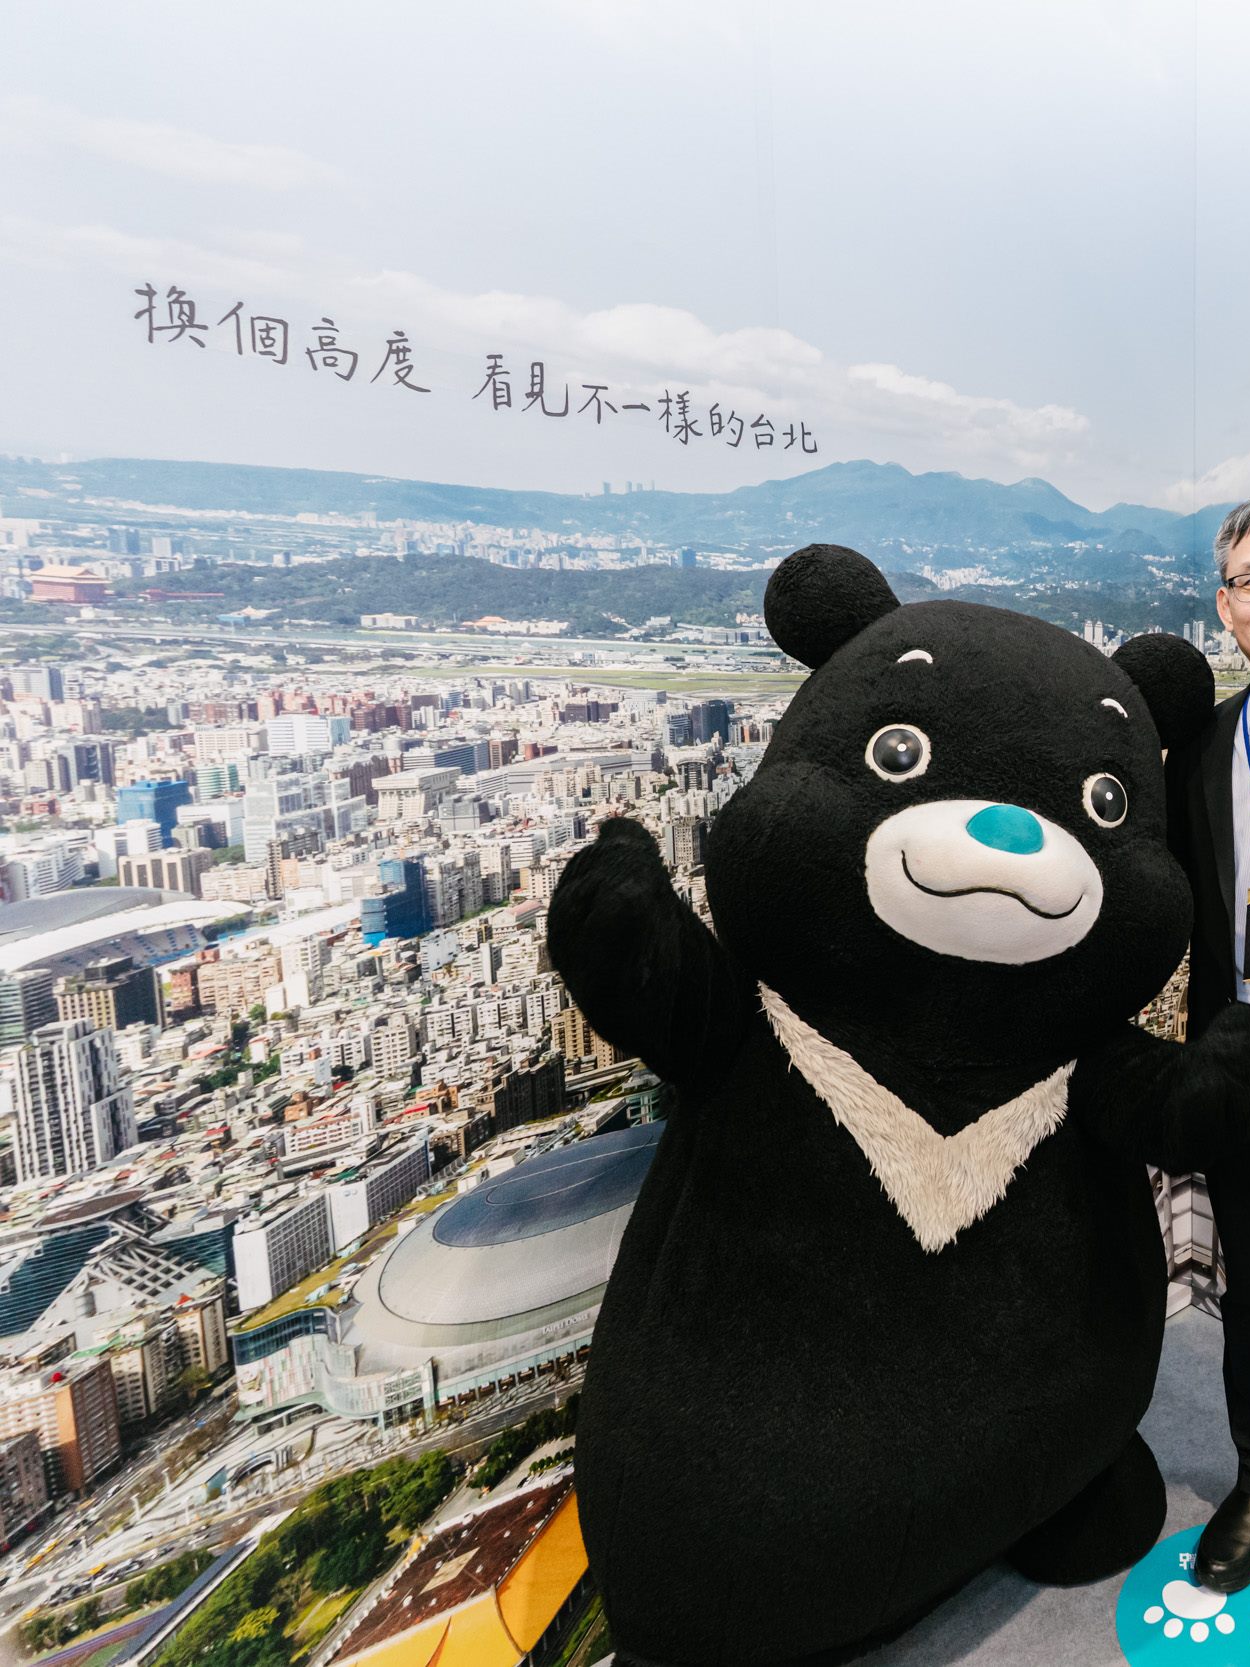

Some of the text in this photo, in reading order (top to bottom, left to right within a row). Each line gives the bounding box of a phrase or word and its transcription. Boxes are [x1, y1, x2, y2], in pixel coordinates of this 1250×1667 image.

[133, 282, 818, 455] 換個高度 看見不一樣的台北
